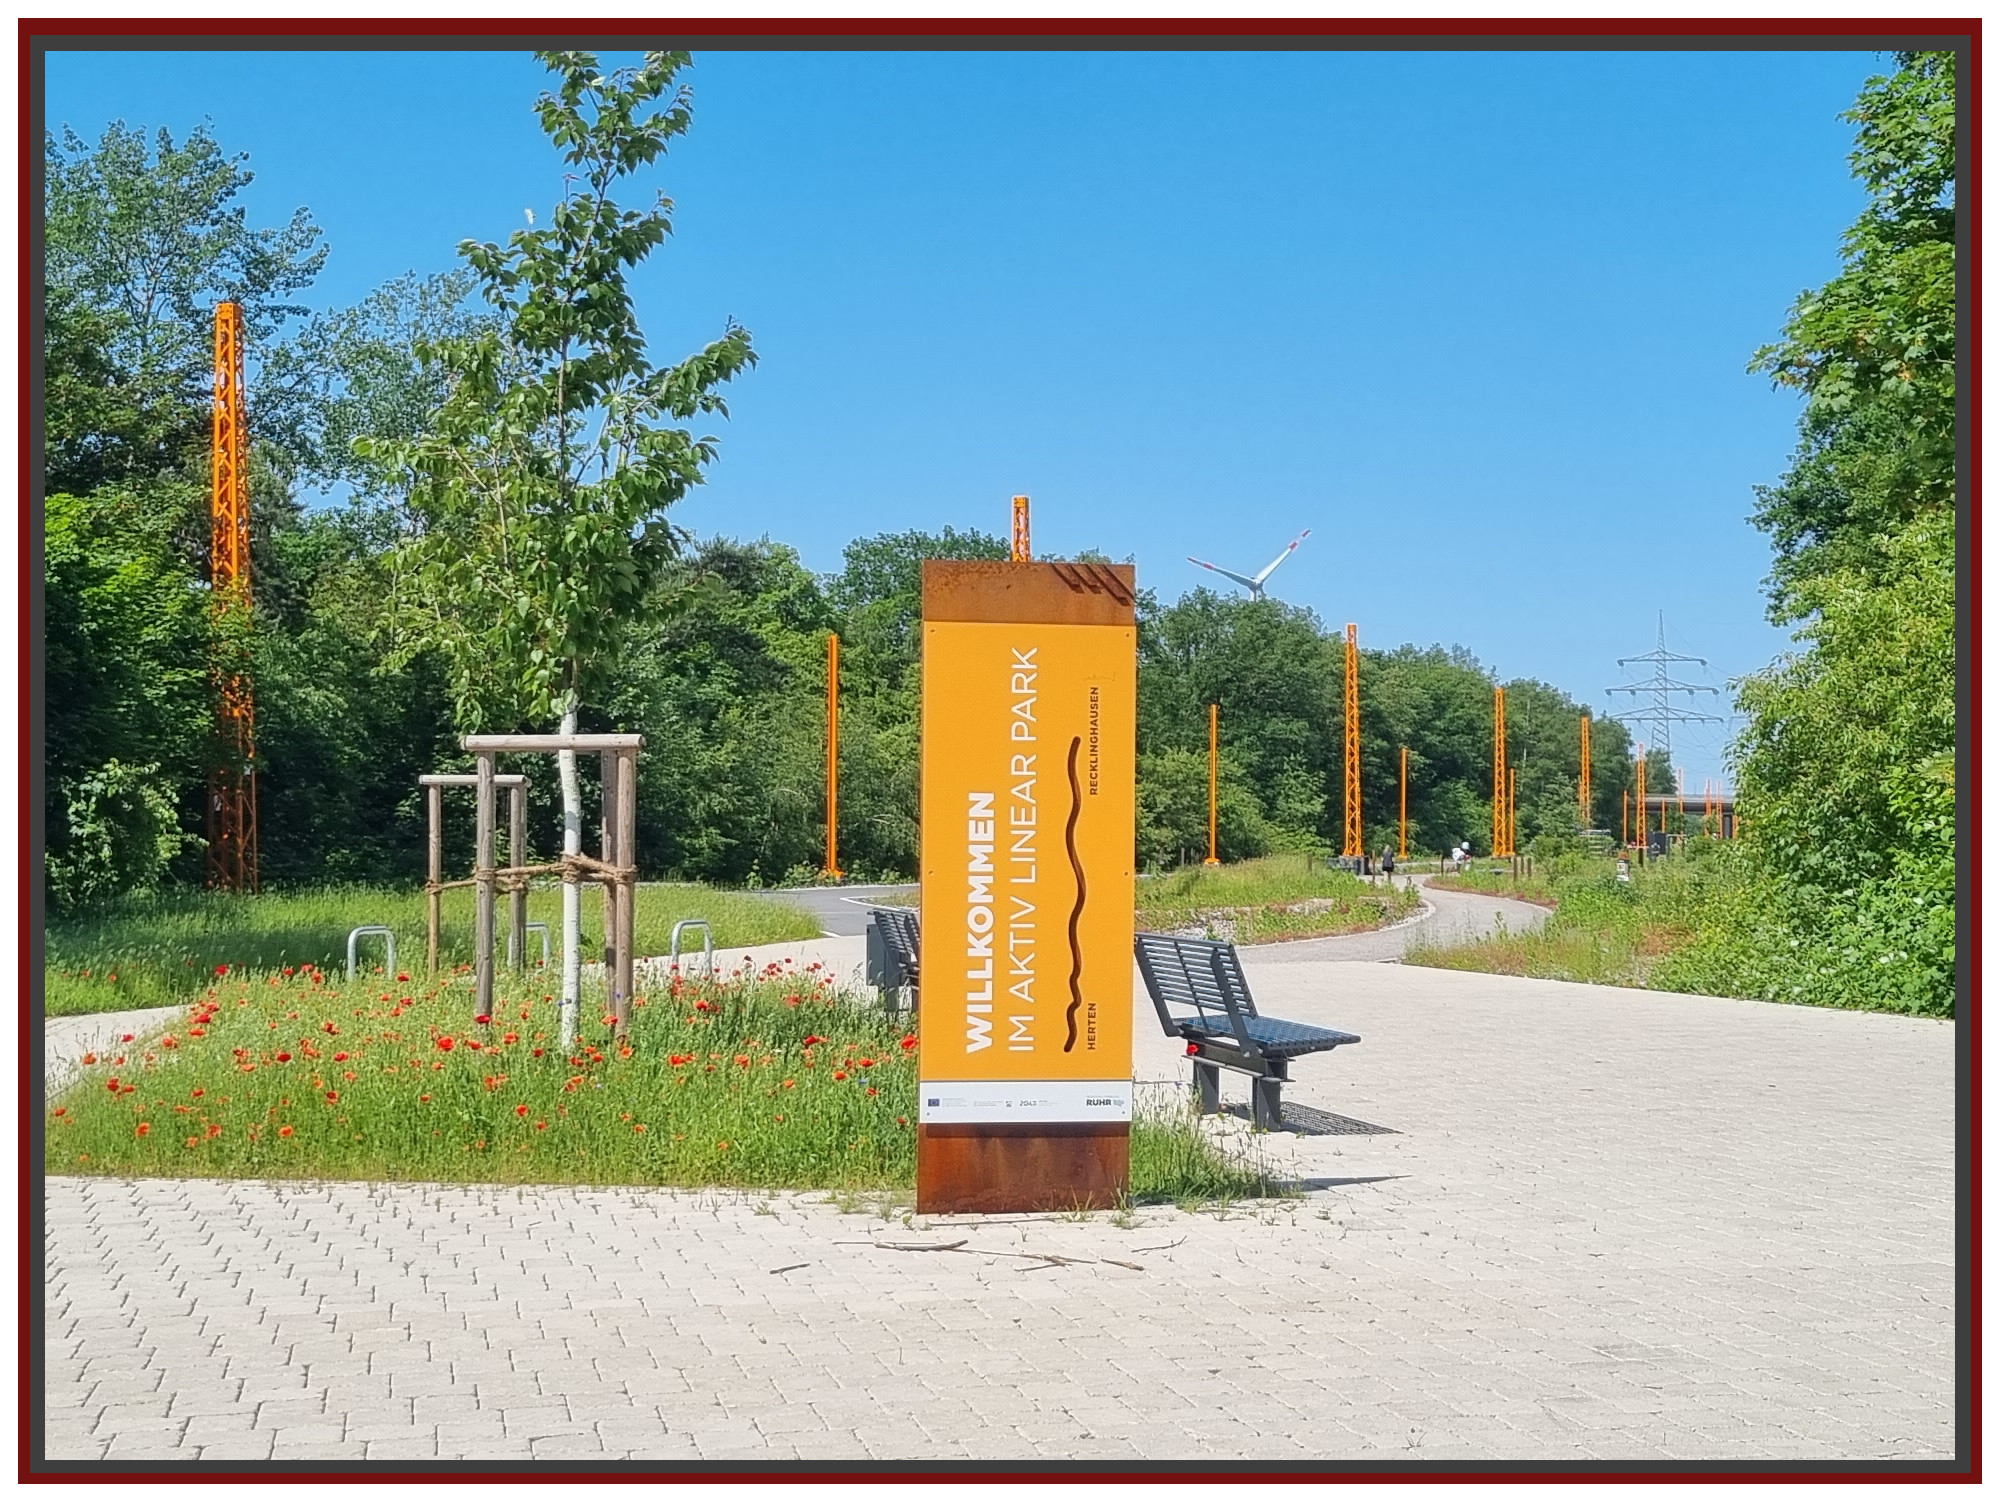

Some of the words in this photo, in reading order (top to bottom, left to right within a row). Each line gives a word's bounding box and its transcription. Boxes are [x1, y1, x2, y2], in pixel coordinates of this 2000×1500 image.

[1010, 647, 1038, 742] PARK
[1089, 687, 1099, 795] RECKLINGHAUSEN
[1009, 754, 1037, 884] LINEAR
[965, 792, 995, 1054] WILLKOMMEN
[1008, 895, 1036, 1003] AKTIV
[1008, 1015, 1035, 1051] IM
[1087, 1002, 1097, 1050] HERTEN
[1086, 1098, 1112, 1106] RUHR
